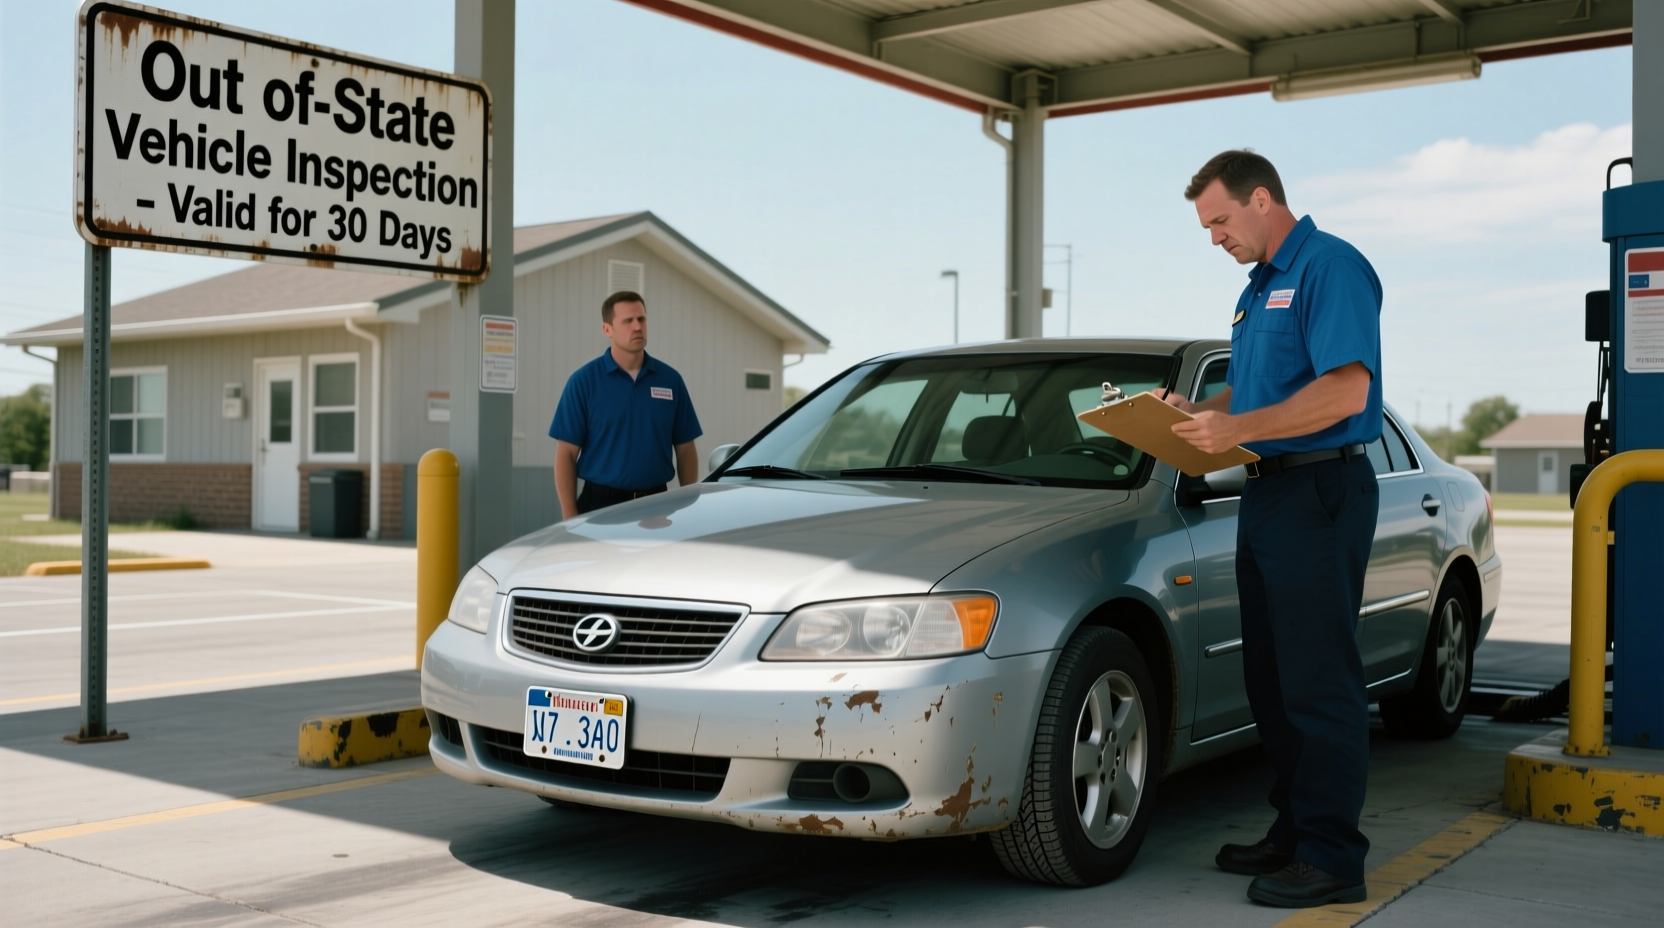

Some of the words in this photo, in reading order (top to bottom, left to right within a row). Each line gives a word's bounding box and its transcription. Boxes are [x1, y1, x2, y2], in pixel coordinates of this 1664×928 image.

[141, 40, 244, 115] Out
[263, 71, 455, 150] of-State
[105, 108, 272, 179] Vehicle
[287, 138, 478, 208] Inspection
[167, 183, 256, 231] Valid
[268, 196, 317, 237] for
[328, 204, 367, 243] 30
[379, 210, 452, 260] Days
